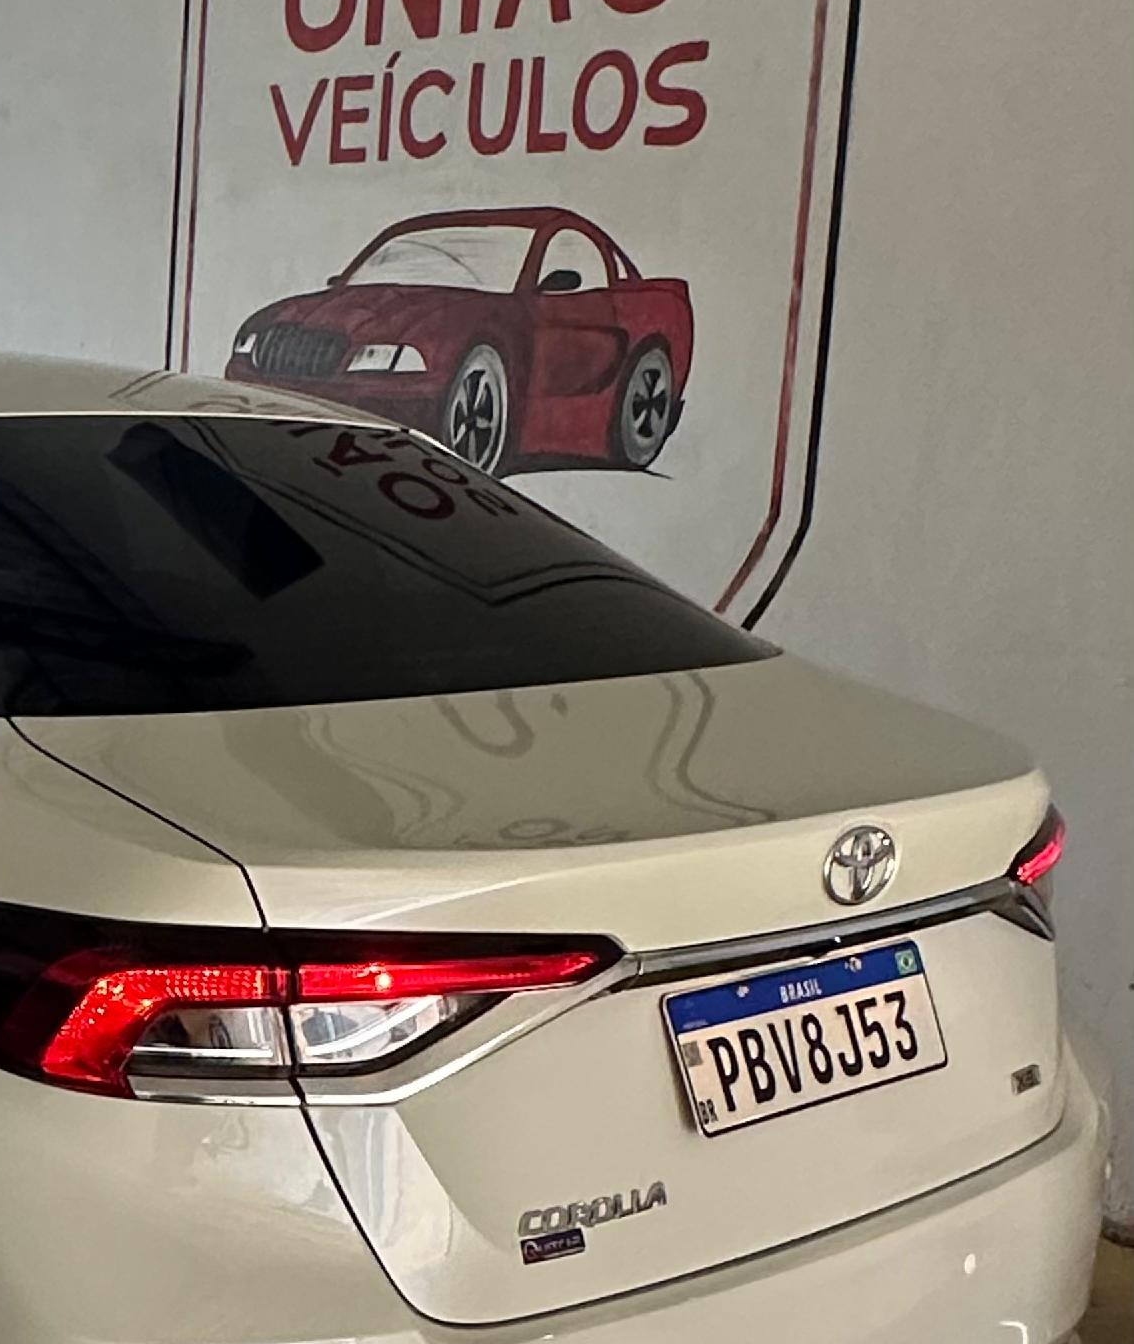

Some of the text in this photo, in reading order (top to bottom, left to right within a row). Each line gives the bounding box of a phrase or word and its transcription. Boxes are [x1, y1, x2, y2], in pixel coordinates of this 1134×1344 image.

[269, 40, 710, 167] VEÍCULOS
[779, 978, 823, 1003] BRASIL
[706, 990, 919, 1113] PBV8J53
[698, 1099, 719, 1125] BR
[518, 1180, 668, 1237] COROLLA
